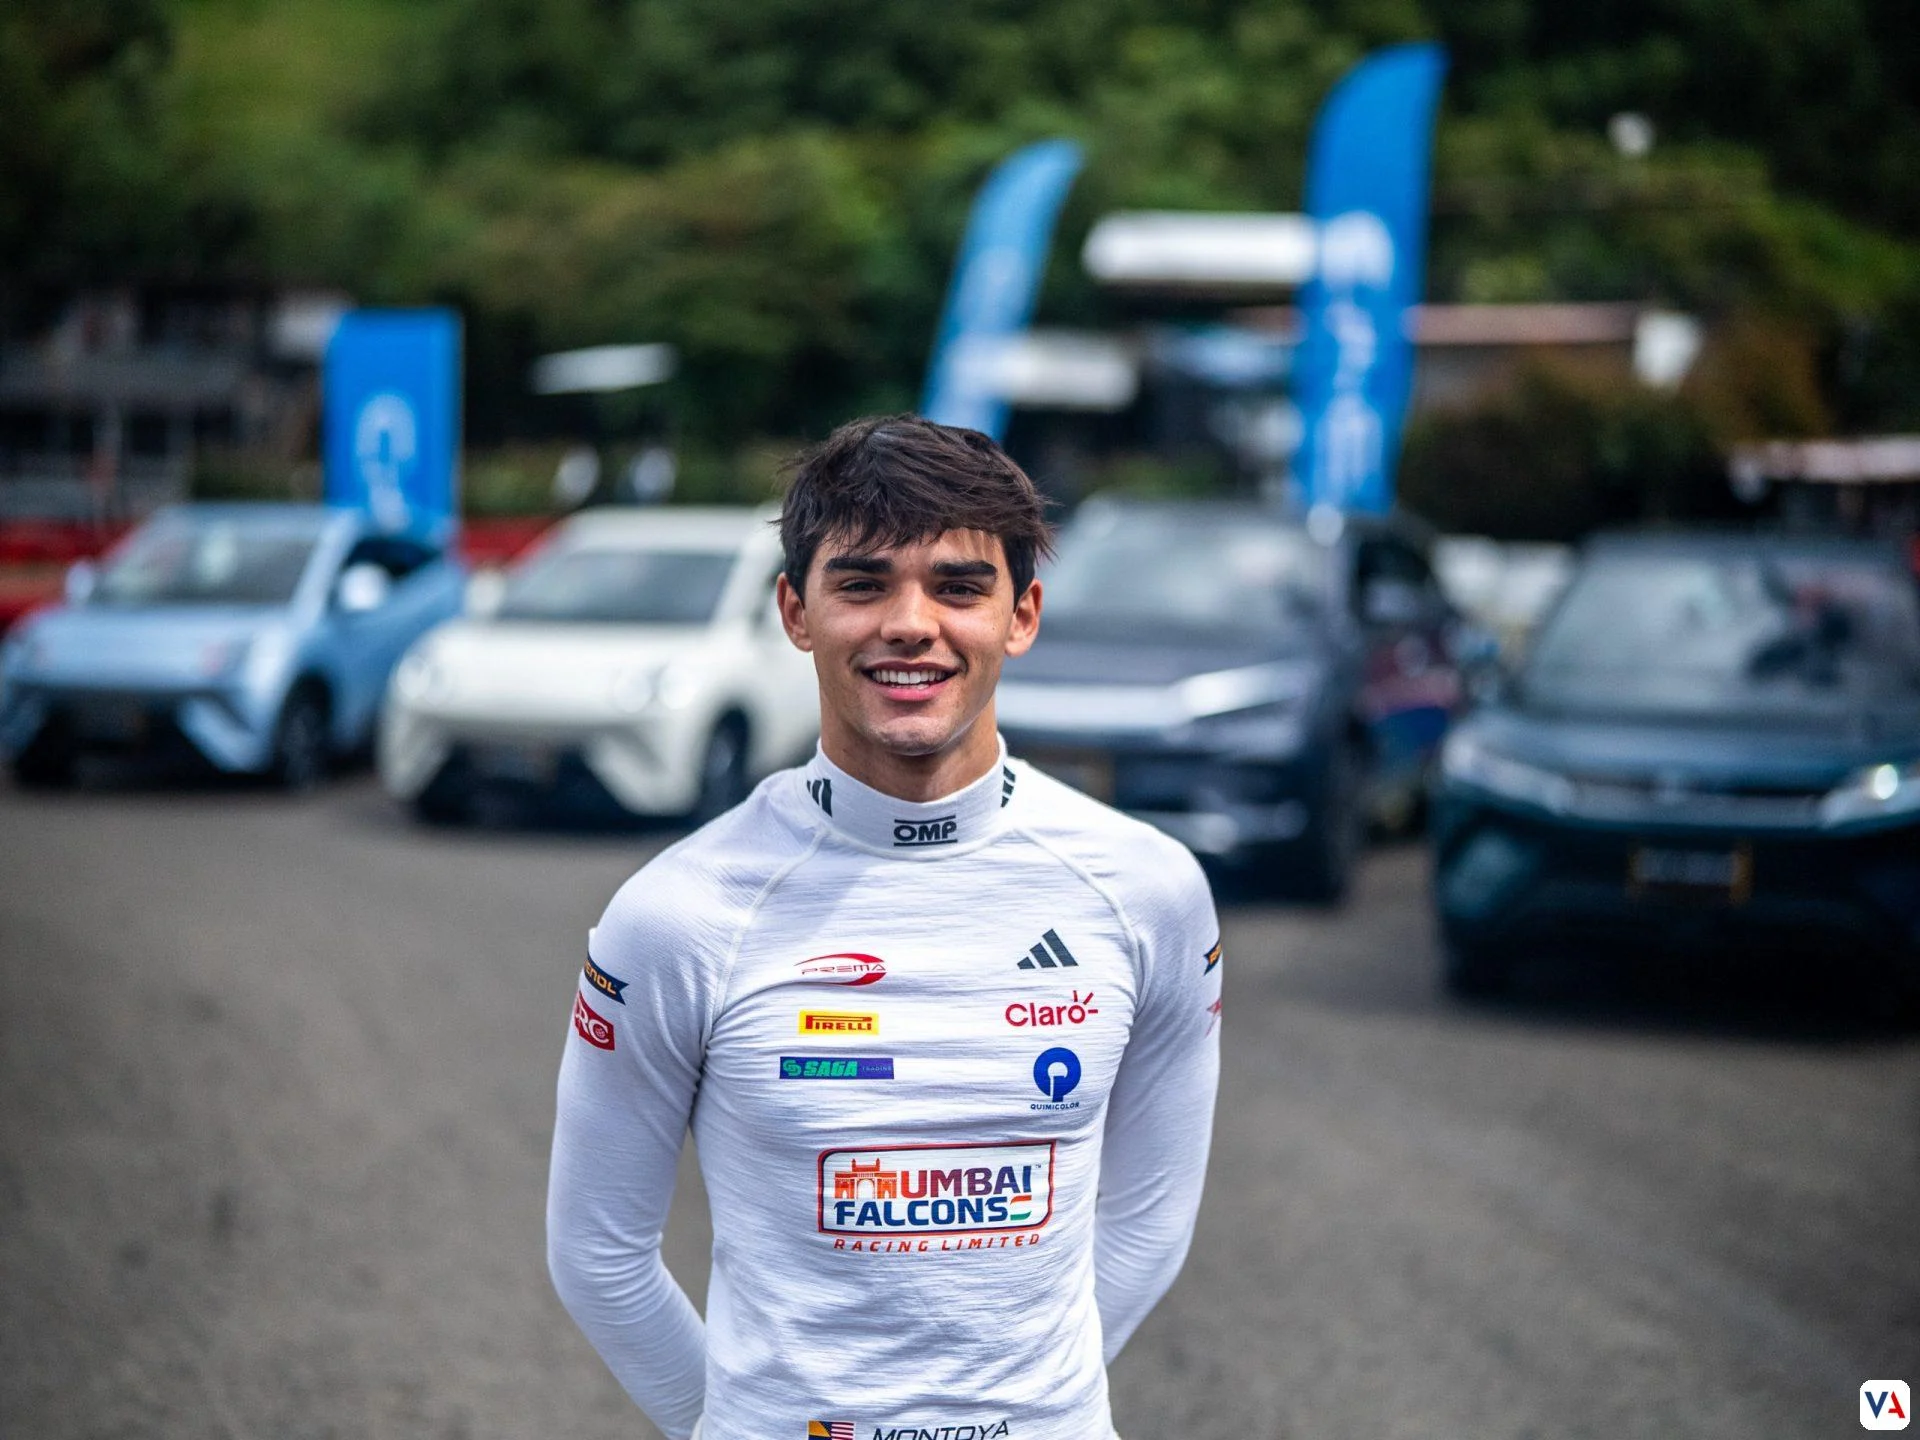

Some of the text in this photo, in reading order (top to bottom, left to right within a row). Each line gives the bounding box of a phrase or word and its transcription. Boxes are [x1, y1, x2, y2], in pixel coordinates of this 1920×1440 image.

[893, 820, 957, 842] OMP
[583, 959, 617, 995] ENOL
[801, 963, 887, 976] PREMA
[805, 1014, 873, 1031] PIRELLI
[1005, 1001, 1086, 1027] Claro
[803, 1059, 858, 1077] SAGA
[1030, 1101, 1080, 1110] QUIMICOLOR
[833, 1195, 1009, 1227] FALCONS
[833, 1233, 1041, 1253] RACING LIMITED
[872, 1420, 1009, 1440] MONTOYA
